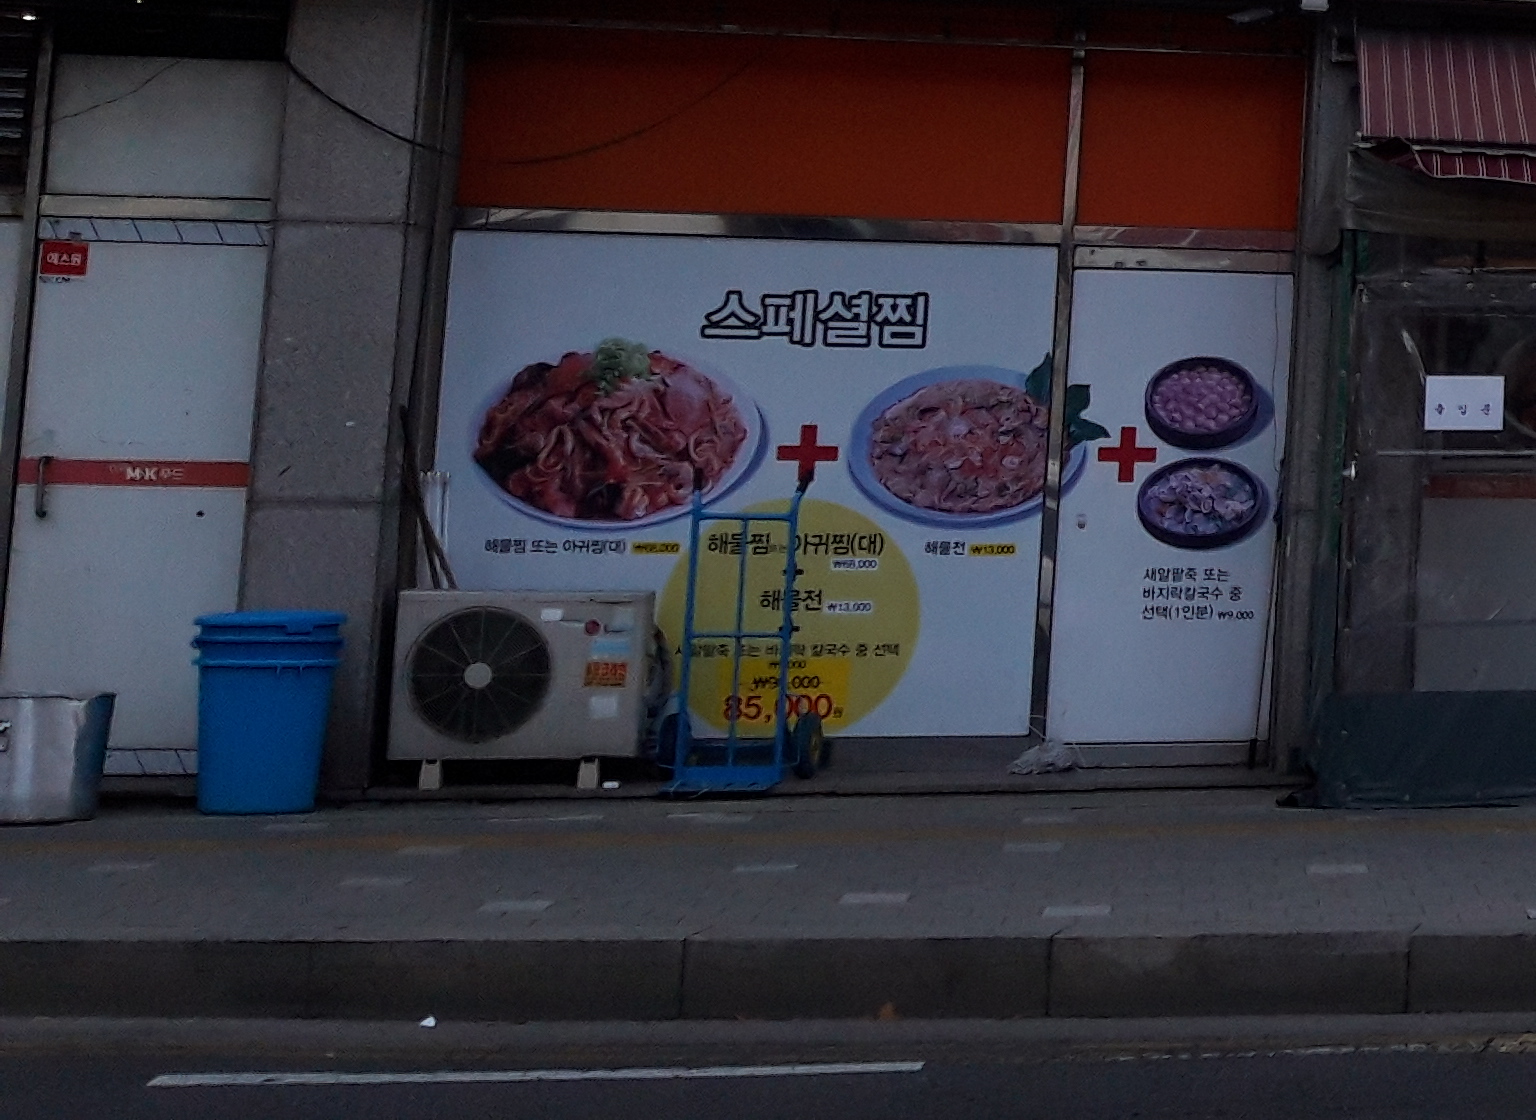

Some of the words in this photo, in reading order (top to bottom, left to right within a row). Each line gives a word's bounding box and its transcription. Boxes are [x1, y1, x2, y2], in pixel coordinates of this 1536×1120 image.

[700, 289, 929, 348] 스페셜찜
[924, 540, 966, 556] 해물전
[1203, 567, 1231, 582] 또는
[1229, 586, 1243, 602] 중
